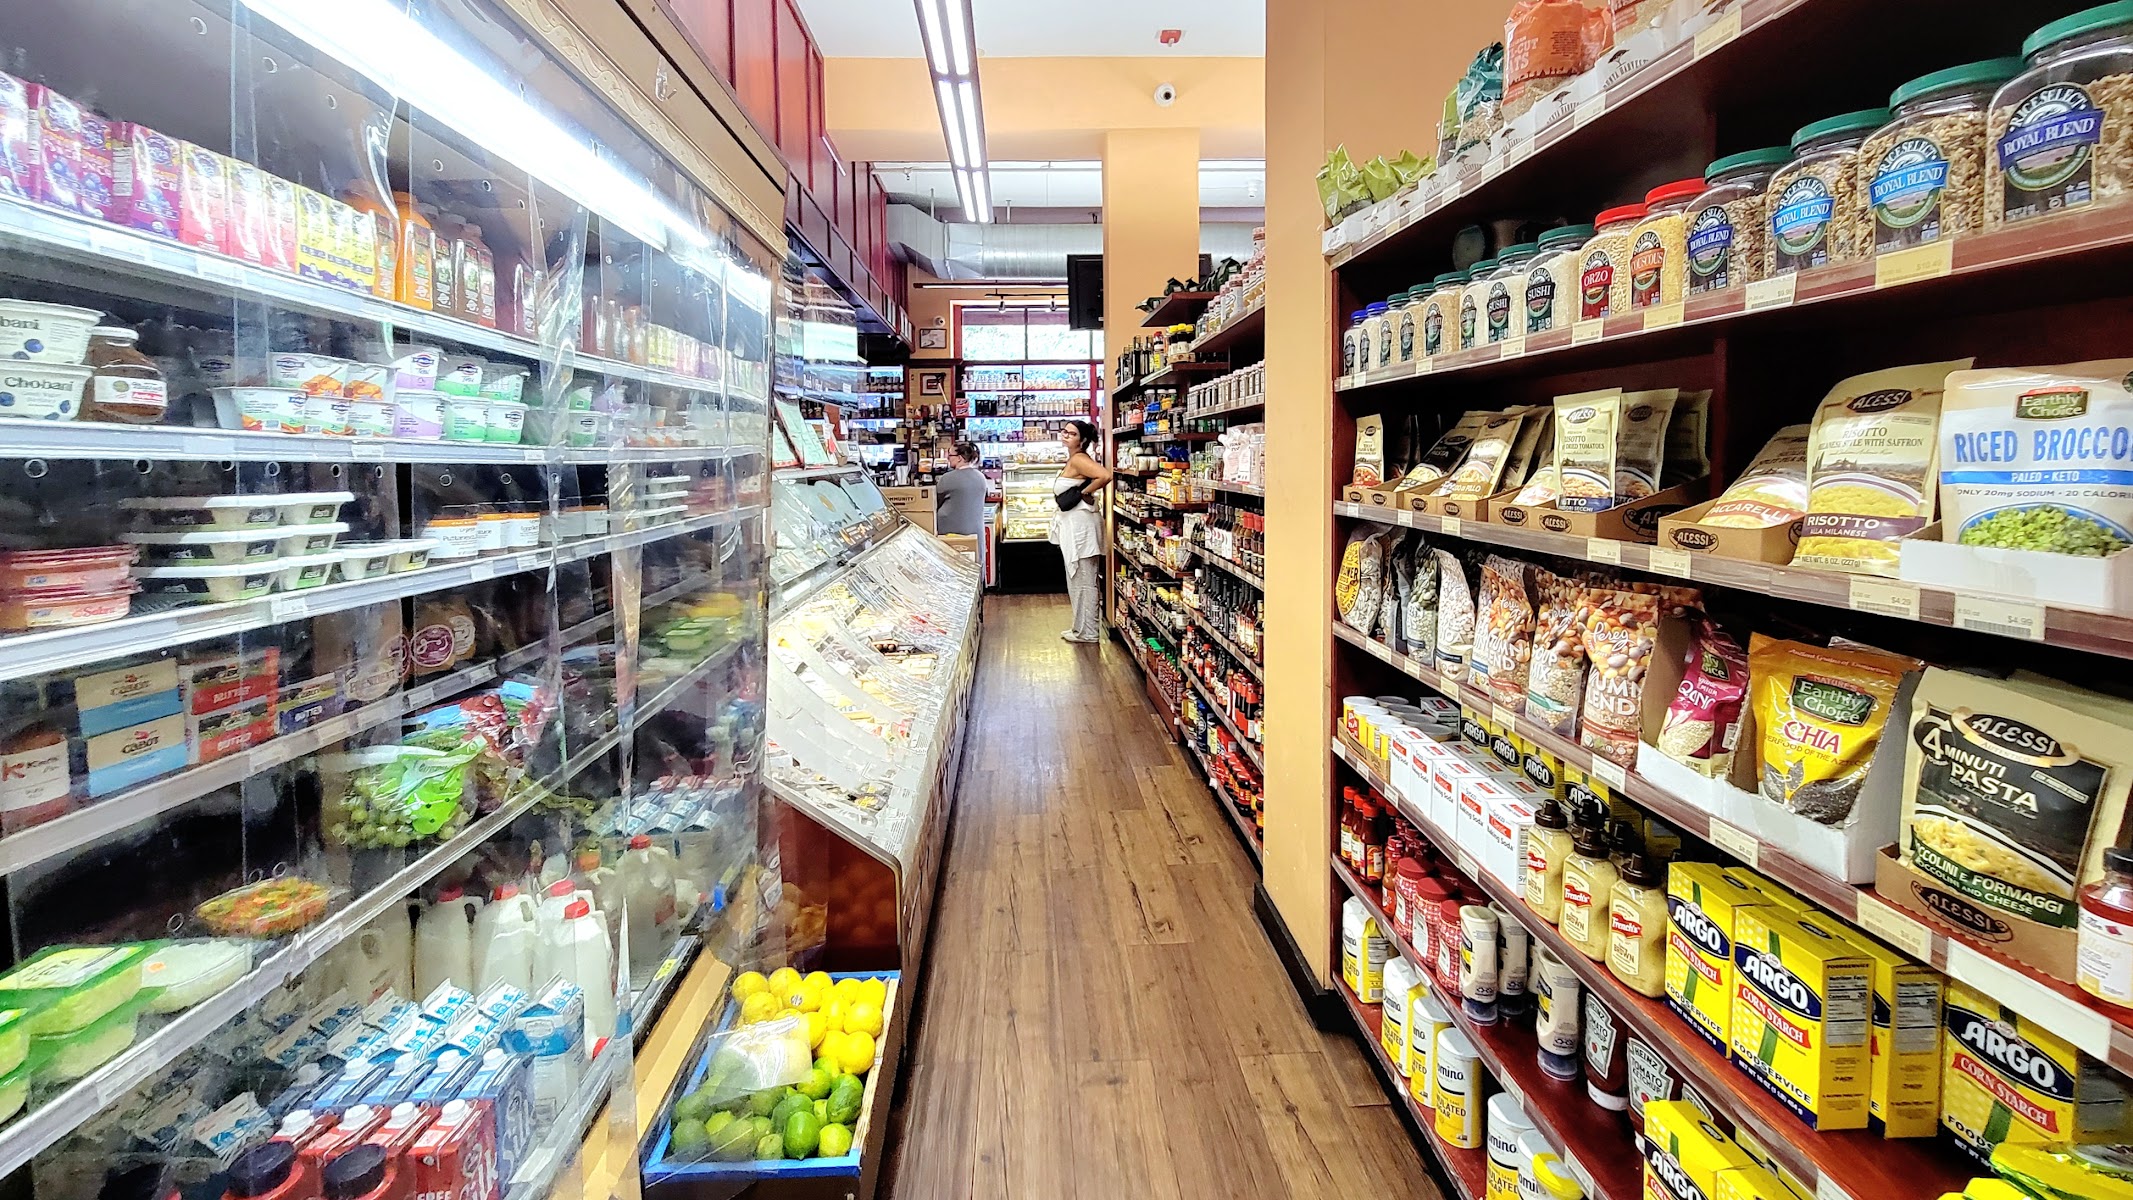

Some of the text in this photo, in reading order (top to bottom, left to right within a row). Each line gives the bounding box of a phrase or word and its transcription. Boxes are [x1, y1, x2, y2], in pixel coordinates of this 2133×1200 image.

[2011, 87, 2087, 128] RICESELECT
[2003, 116, 2096, 158] ROYAL BLEND
[1879, 139, 1935, 174] RICESELECT
[1873, 165, 1944, 198] ROYAL BLEND
[1779, 180, 1825, 208] RICESELECT
[1775, 200, 1830, 230] ROYAL BLEND
[1583, 270, 1609, 286] ORZO
[1527, 284, 1552, 299] SUSHI
[1488, 300, 1508, 314] SUSHI
[0, 317, 39, 330] bani
[4, 376, 74, 392] Chobani
[1852, 390, 1908, 411] ALESSI
[2022, 392, 2081, 411] Earthly
[2027, 405, 2083, 418] Choice
[1842, 426, 1889, 439] RISOTTO
[1863, 438, 1924, 448] WITH SAFFRON
[1954, 425, 2133, 464] RICED BROCCO
[1578, 442, 1605, 450] TOMATOES
[2011, 471, 2080, 483] PALEO KETO
[1984, 489, 2013, 498] 20mg
[2016, 490, 2055, 498] SODIUM
[2083, 489, 2133, 499] CALORI
[1503, 510, 1523, 520] ALESSI
[1544, 517, 1566, 529] ALESSI
[1807, 515, 1880, 530] RISOTTO
[1676, 531, 1709, 546] ALESSI
[1824, 529, 1868, 538] MILANESE
[1489, 635, 1525, 657] TUMN
[1591, 621, 1634, 652] Pereg
[1532, 645, 1558, 666] SOUP
[1530, 663, 1551, 682] MIX
[1799, 681, 1862, 711] Earthly
[1803, 695, 1861, 724] Choice
[1463, 721, 1486, 743] ARGO
[1784, 720, 1840, 754] CHIA
[1922, 728, 1945, 759] 4
[1972, 716, 2056, 755] ALESSI
[121, 736, 160, 754] CABOT
[1493, 739, 1516, 763] ARGO
[1804, 747, 1831, 762] OF THE
[1525, 758, 1550, 784] ARGO
[1944, 744, 2008, 779] MINUTI
[1950, 765, 2040, 814] PASTA
[1564, 887, 1591, 904] French's
[1960, 871, 2064, 916] E FORMAGGI
[1961, 885, 2033, 916] AND CHEESE
[1927, 892, 1995, 932] ALESSI
[1611, 916, 1642, 935] French's
[1673, 908, 1720, 951] ARGO
[1613, 945, 1635, 964] BROWN
[1672, 934, 1718, 981] CORN STARCH
[1745, 952, 1808, 1010] ARGO
[1666, 981, 1723, 1035] FOODSERVICE
[1741, 986, 1805, 1044] CORN STARCH
[1413, 1024, 1426, 1040] ino
[1635, 1045, 1659, 1071] HEINZ
[1960, 1020, 2056, 1088] ARGO
[1437, 1063, 1464, 1082] omino
[1630, 1055, 1663, 1088] TOMATO
[1632, 1066, 1662, 1095] KETCHUP
[1734, 1038, 1812, 1105] FOODSERVICE
[1738, 1060, 1749, 1071] NET
[1748, 1068, 1757, 1077] WT
[1959, 1056, 2049, 1127] CORN STARCH
[1489, 1135, 1517, 1154] omino
[1651, 1149, 1703, 1200] ARGO
